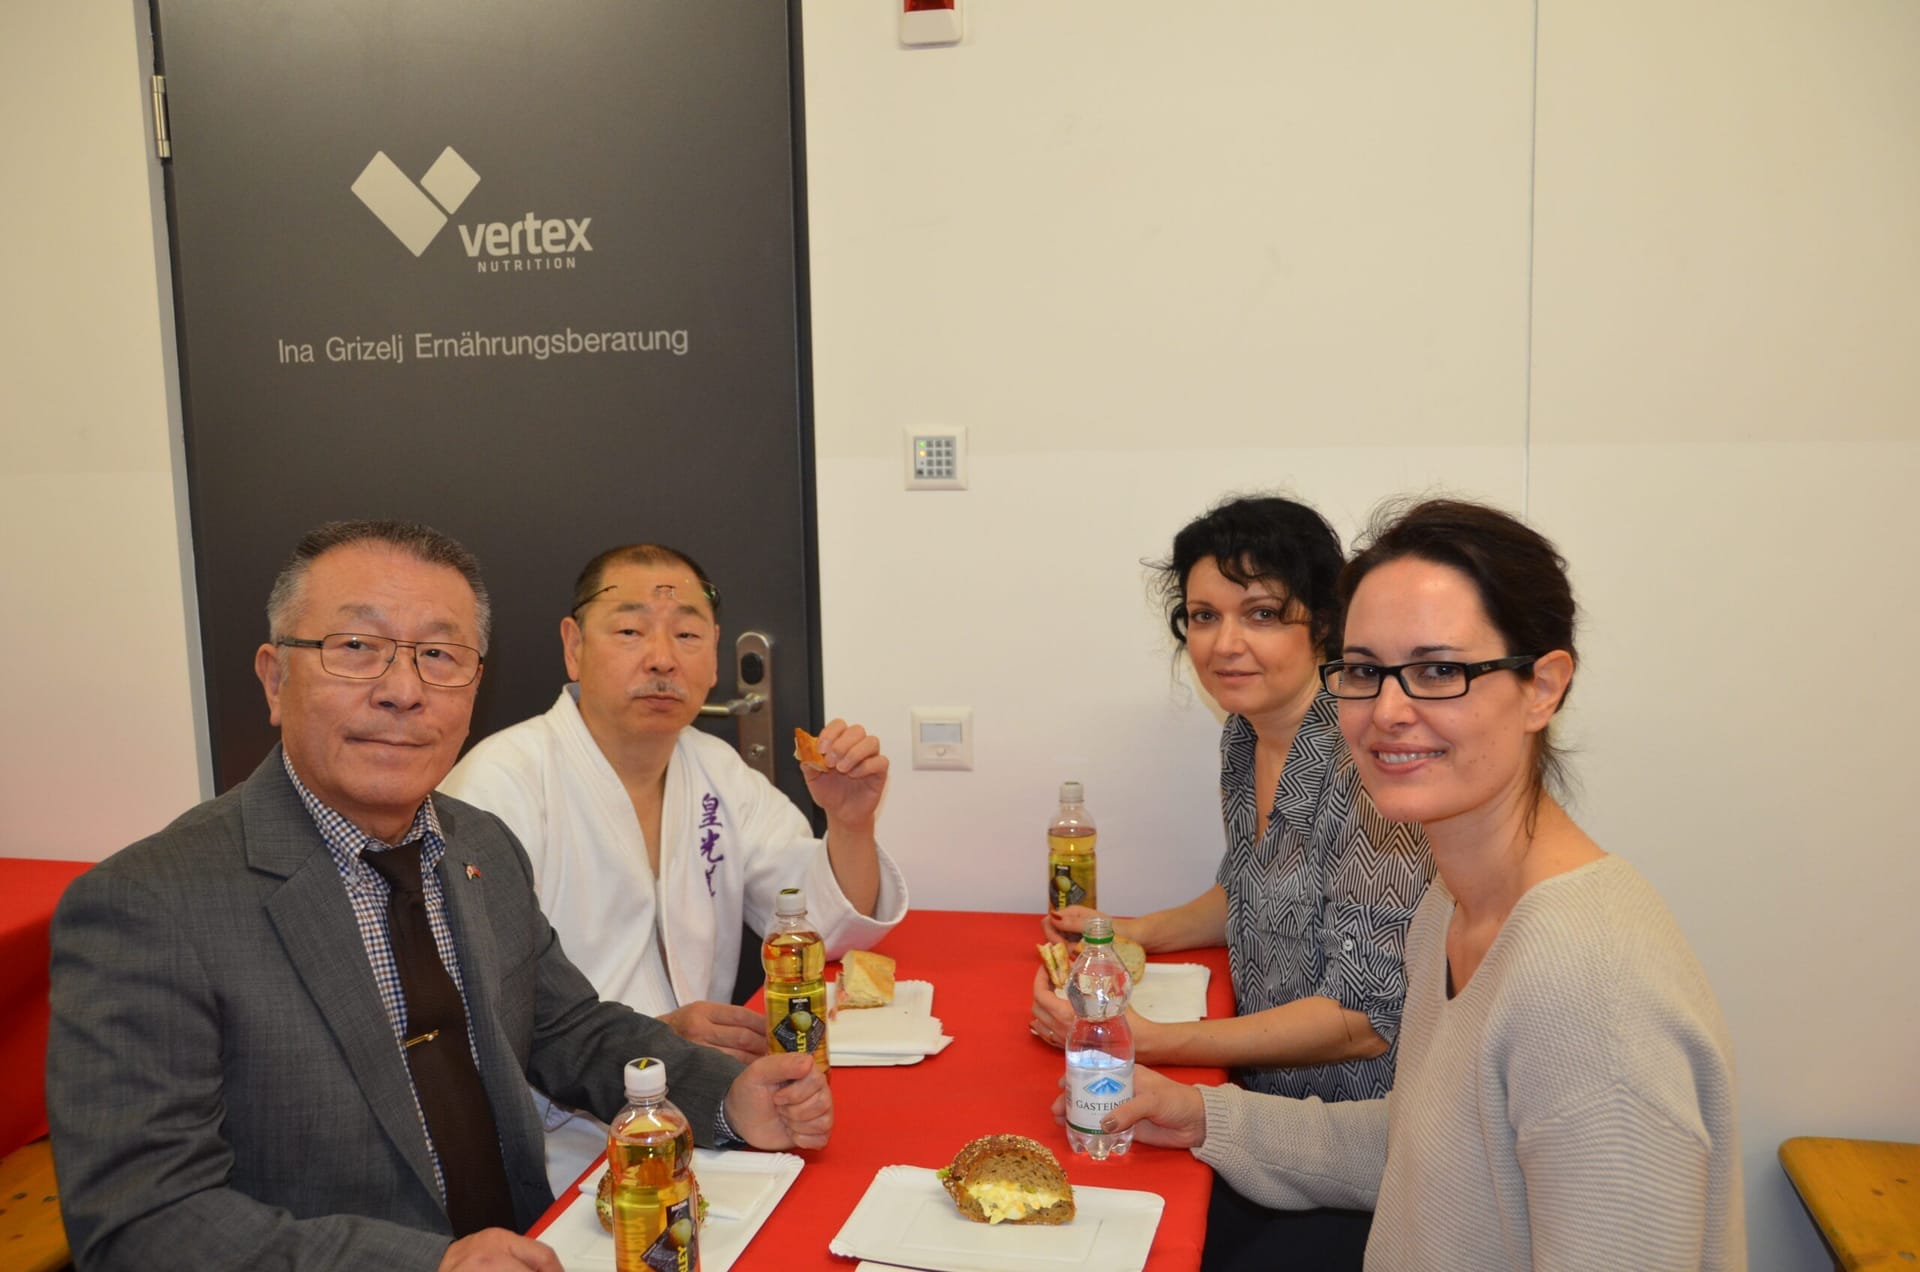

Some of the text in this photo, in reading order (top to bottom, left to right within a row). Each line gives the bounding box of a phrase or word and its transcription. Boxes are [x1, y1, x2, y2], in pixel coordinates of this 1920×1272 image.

[457, 211, 594, 257] vertex
[478, 257, 576, 272] NUTRITION
[278, 327, 689, 364] Ina Grizelj Ernährungsberatung
